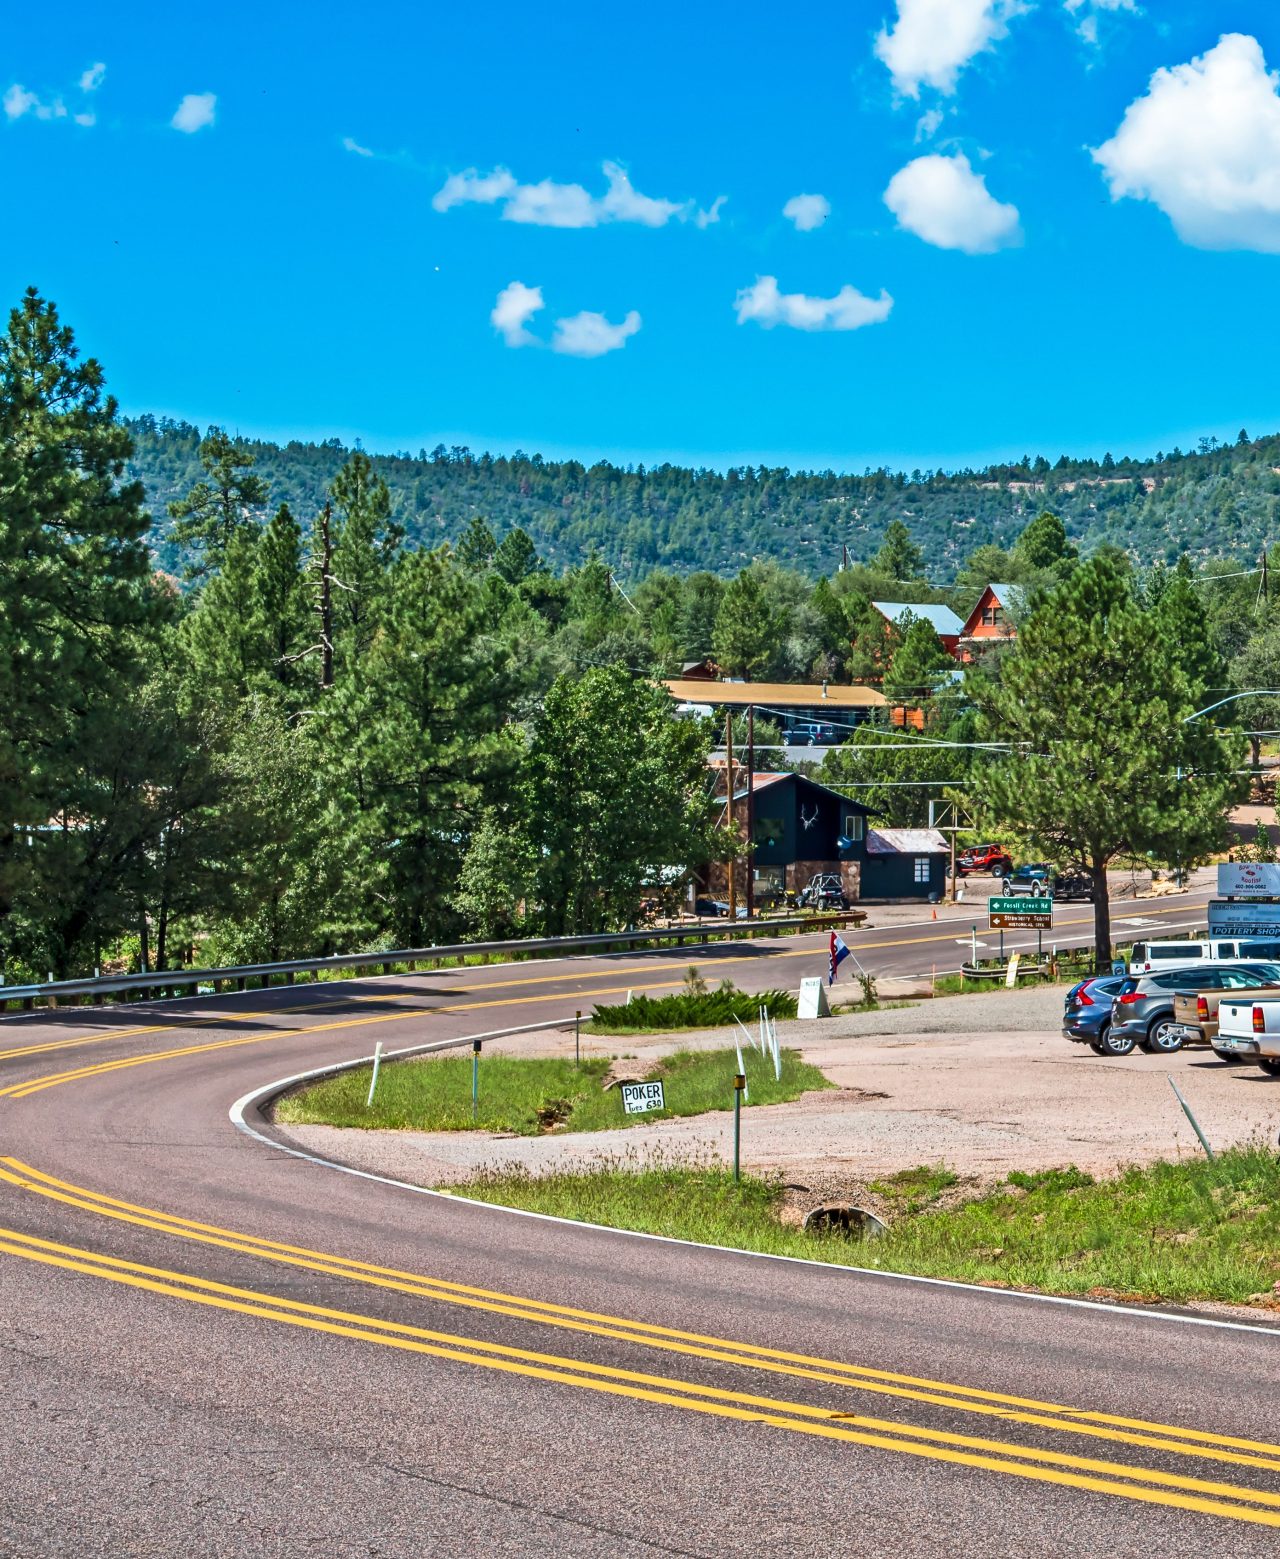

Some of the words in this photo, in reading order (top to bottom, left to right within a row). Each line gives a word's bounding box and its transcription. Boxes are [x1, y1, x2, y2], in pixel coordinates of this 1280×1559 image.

[1214, 927, 1255, 935] POTTERY
[624, 1084, 661, 1101] POKER
[626, 1102, 643, 1112] Tues
[646, 1099, 662, 1110] 630
